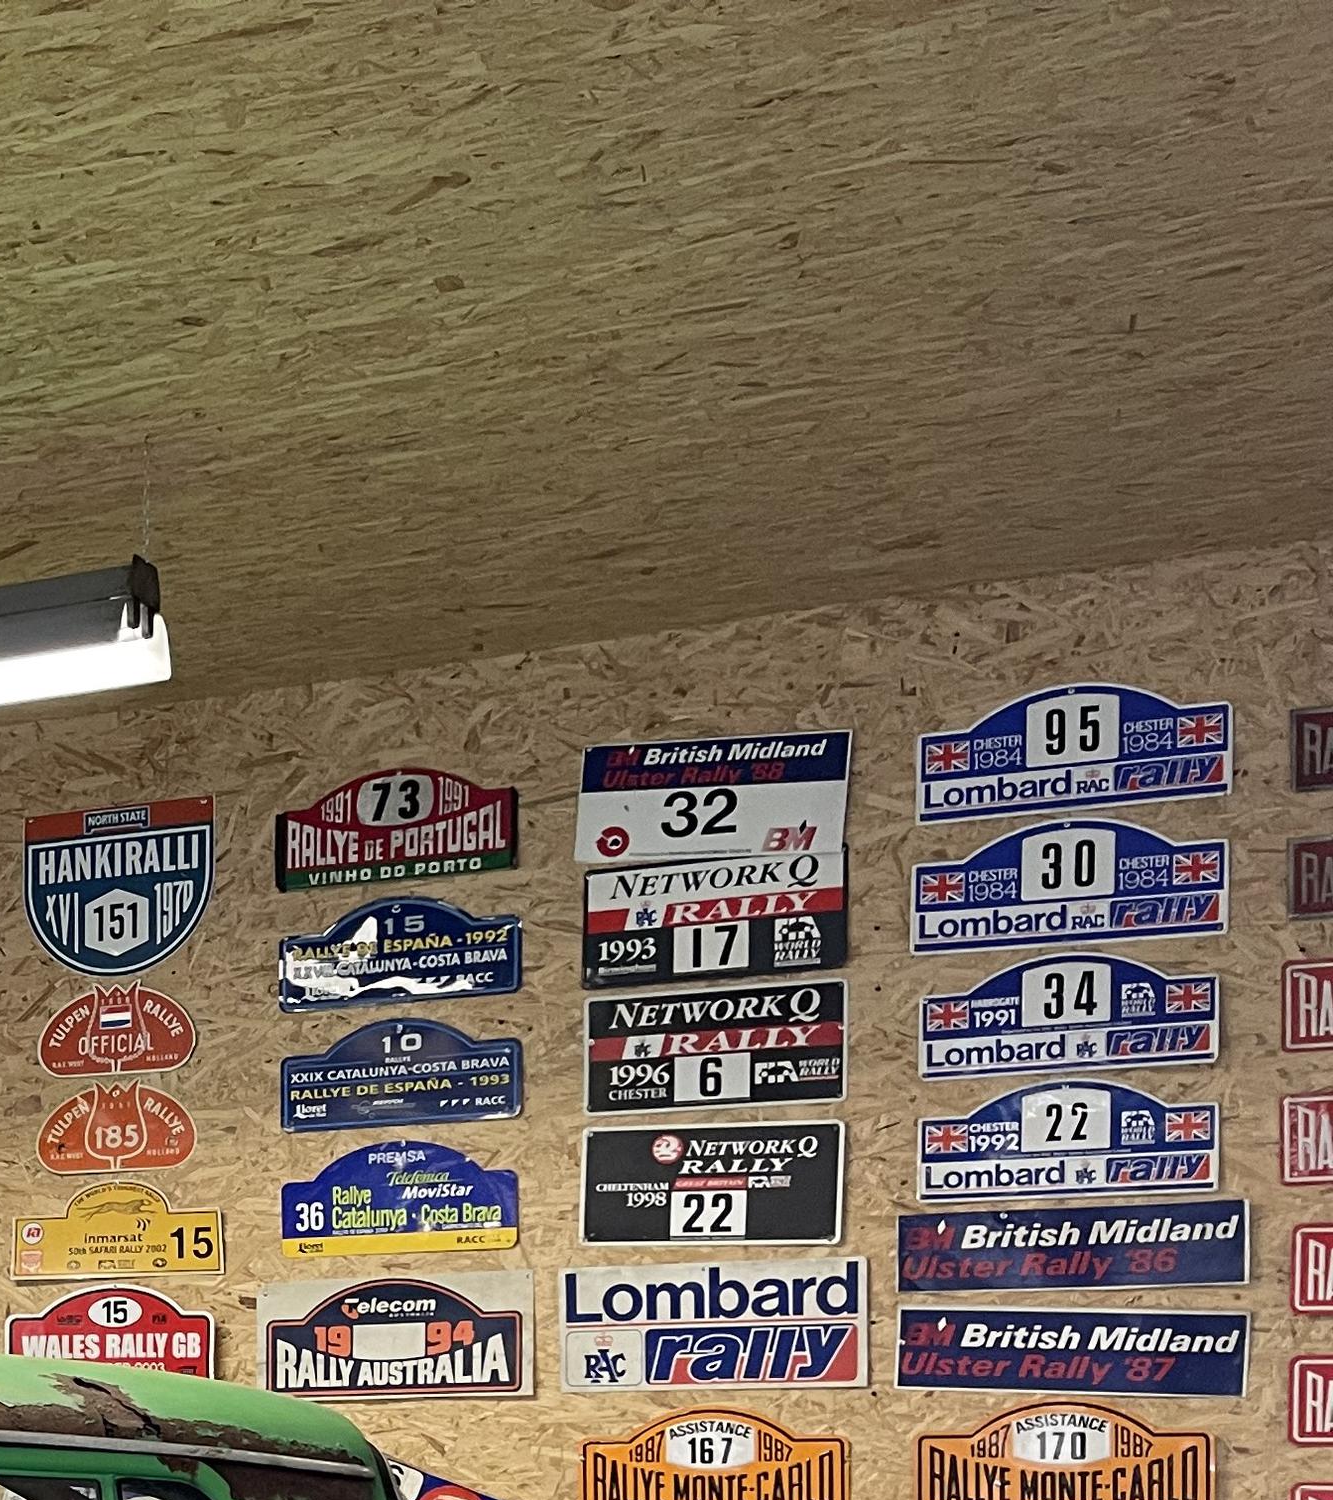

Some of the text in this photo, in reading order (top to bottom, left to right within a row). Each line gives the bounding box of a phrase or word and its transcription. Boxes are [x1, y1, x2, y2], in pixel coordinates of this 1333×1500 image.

[1045, 704, 1100, 756] 95
[1123, 718, 1173, 734] CHESTER
[643, 739, 828, 766] British Midland
[972, 734, 1022, 751] CHESTER
[1123, 733, 1173, 754] 1984
[974, 751, 1023, 771] 1984
[371, 780, 421, 822] 73
[661, 788, 738, 837] 32
[287, 800, 506, 869] RALLYE DE PORTUGAL
[308, 856, 482, 886] VINHO DO PORTO
[968, 868, 1018, 883] CHESTER
[1042, 839, 1096, 890] 30
[1119, 854, 1169, 870] CHESTER
[610, 855, 819, 899] NETWORK Q
[1119, 869, 1169, 890] 1984
[968, 883, 1018, 902] 1984
[93, 902, 138, 942] 151
[666, 891, 818, 925] RALLY
[598, 937, 657, 962] 1993
[1044, 970, 1097, 1020] 34
[49, 1005, 90, 1048] TULPEN
[143, 999, 183, 1037] RALLYE
[973, 1009, 1016, 1028] 1991
[78, 1032, 153, 1055] OFFICIAL
[665, 1024, 821, 1055] RALLY
[925, 1034, 1065, 1068] Lombard
[1110, 1024, 1207, 1056] rally
[291, 1073, 510, 1100] RALLYE DE ESPAÑA 1993
[609, 1063, 670, 1086] 1996
[699, 1057, 723, 1098] 6
[609, 1087, 667, 1101] CHESTER
[143, 1097, 185, 1137] RALLYE
[1046, 1101, 1089, 1142] 22
[95, 1124, 139, 1149] 185
[969, 1134, 1019, 1152] 1992
[368, 1150, 426, 1164] PREMSA
[679, 1157, 793, 1174] RALLY
[332, 1186, 371, 1205] Rallye
[295, 1202, 324, 1231] 36
[332, 1203, 501, 1231] Catalunya Costa Brava
[682, 1193, 733, 1233] 22
[170, 1226, 214, 1259] 15
[961, 1215, 1240, 1250] British Midland
[565, 1261, 859, 1322] Lombard
[102, 1300, 128, 1324] 15
[21, 1332, 201, 1360] WALES RALLY GB
[961, 1323, 1240, 1354] British Midland
[276, 1331, 511, 1389] RALLY AUSTRALIA
[649, 1326, 852, 1384] rally
[669, 1421, 753, 1439] ASSISTANCE
[1016, 1414, 1110, 1434] ASSISTANCE
[688, 1438, 732, 1464] 167
[1037, 1432, 1086, 1460] 170
